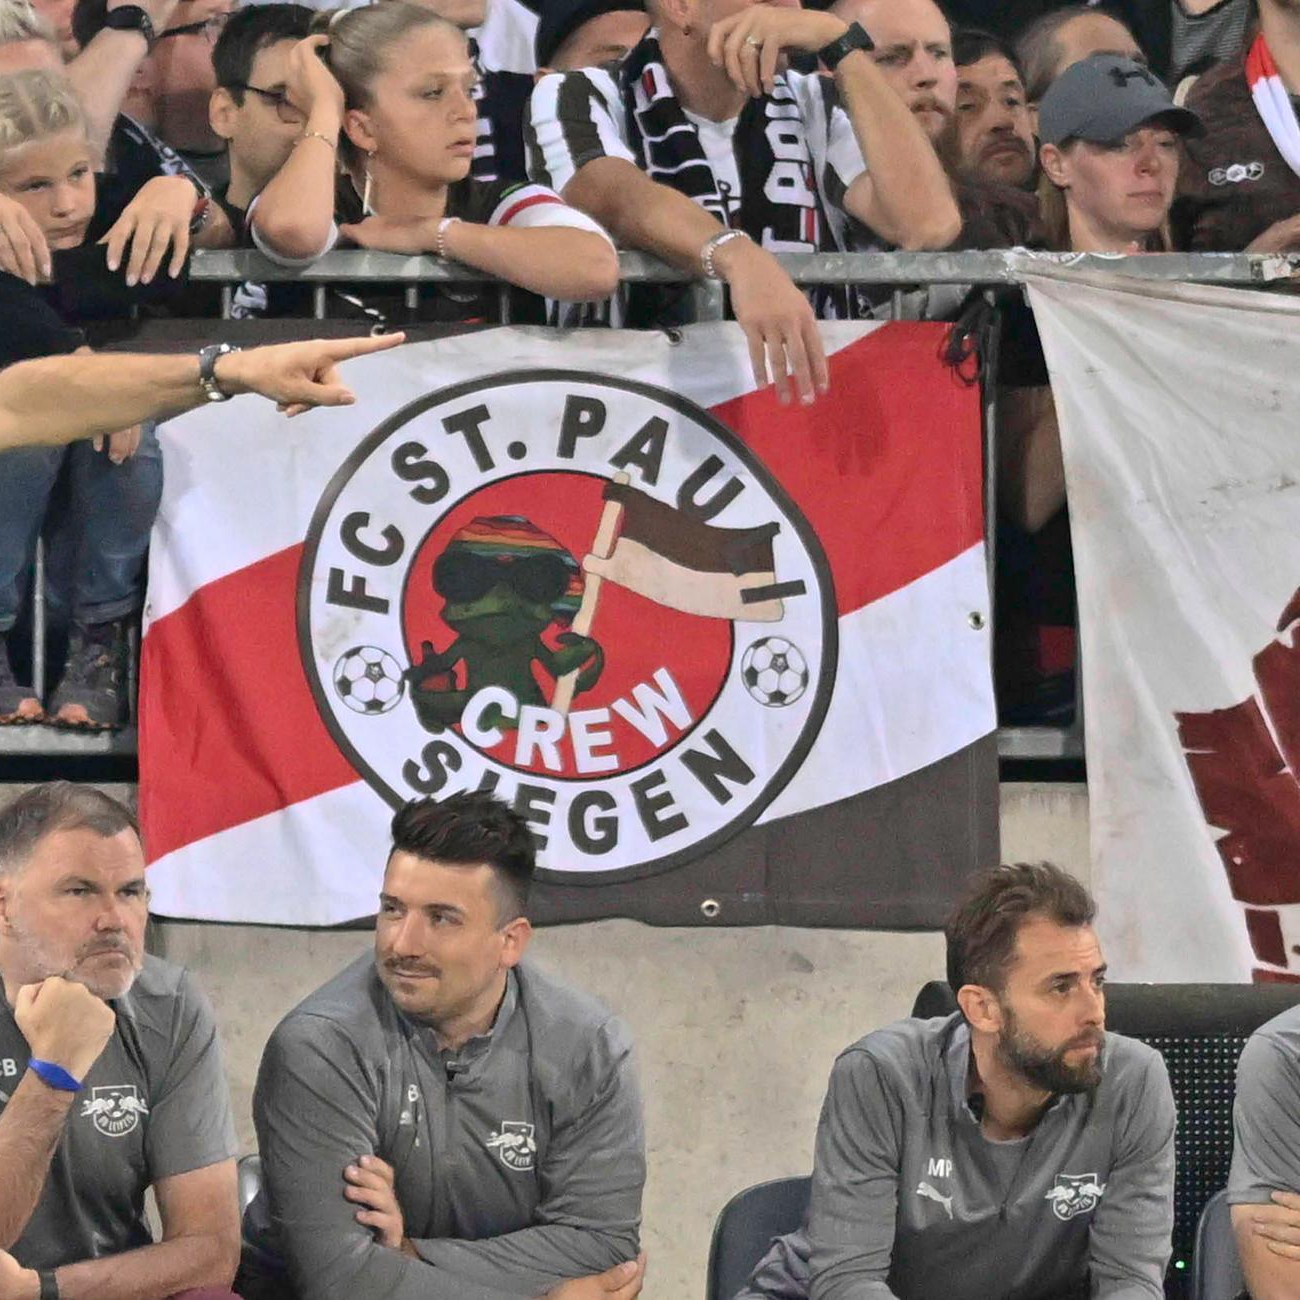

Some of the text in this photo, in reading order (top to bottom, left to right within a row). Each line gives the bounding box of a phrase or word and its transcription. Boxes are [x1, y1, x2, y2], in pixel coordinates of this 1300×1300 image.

[325, 393, 807, 615] FC ST. PAULI
[461, 667, 693, 774] CREW
[927, 1157, 953, 1178] MP
